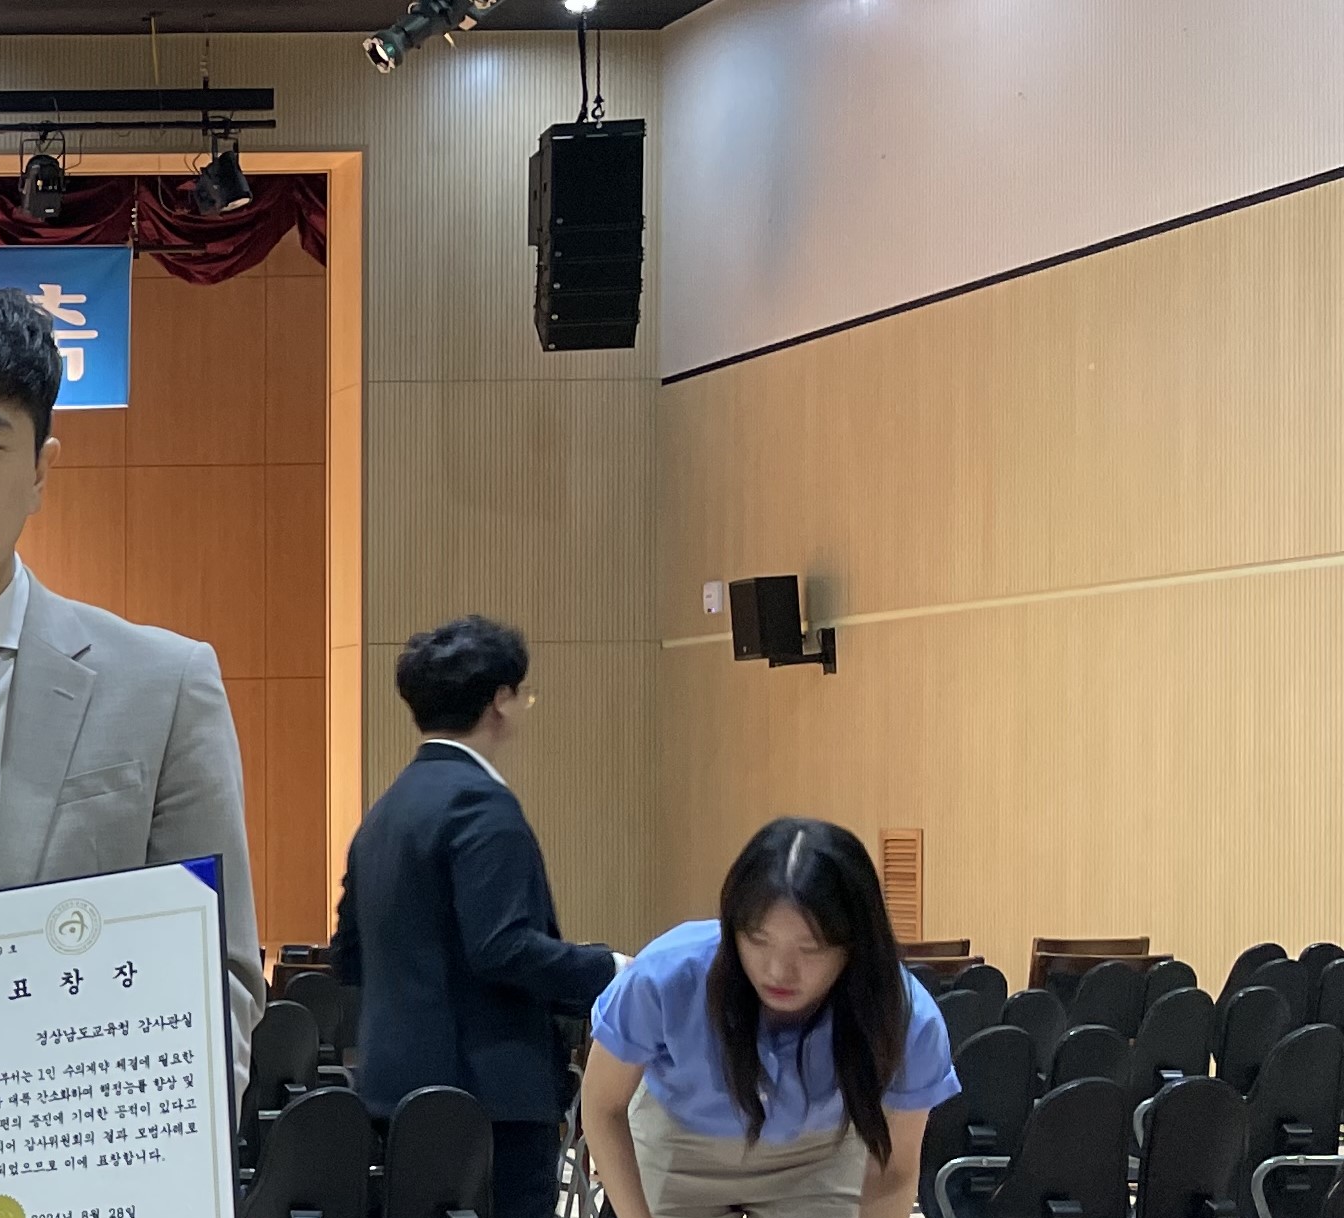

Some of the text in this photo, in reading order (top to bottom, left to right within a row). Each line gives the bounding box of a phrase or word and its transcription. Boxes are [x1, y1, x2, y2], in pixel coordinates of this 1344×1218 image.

[138, 1011, 192, 1034] 감사관실
[158, 1049, 194, 1067] 필요한
[153, 1075, 177, 1092] 향상
[182, 1072, 194, 1089] 및
[0, 1115, 21, 1131] 편의
[28, 1110, 64, 1128] 증진에
[71, 1106, 109, 1123] 기여한
[114, 1101, 151, 1119] 공적이
[159, 1098, 197, 1114] 있다고
[134, 1121, 198, 1140] 모범사례로
[64, 1154, 88, 1171] 이에
[96, 1148, 166, 1167] 표창합니다.
